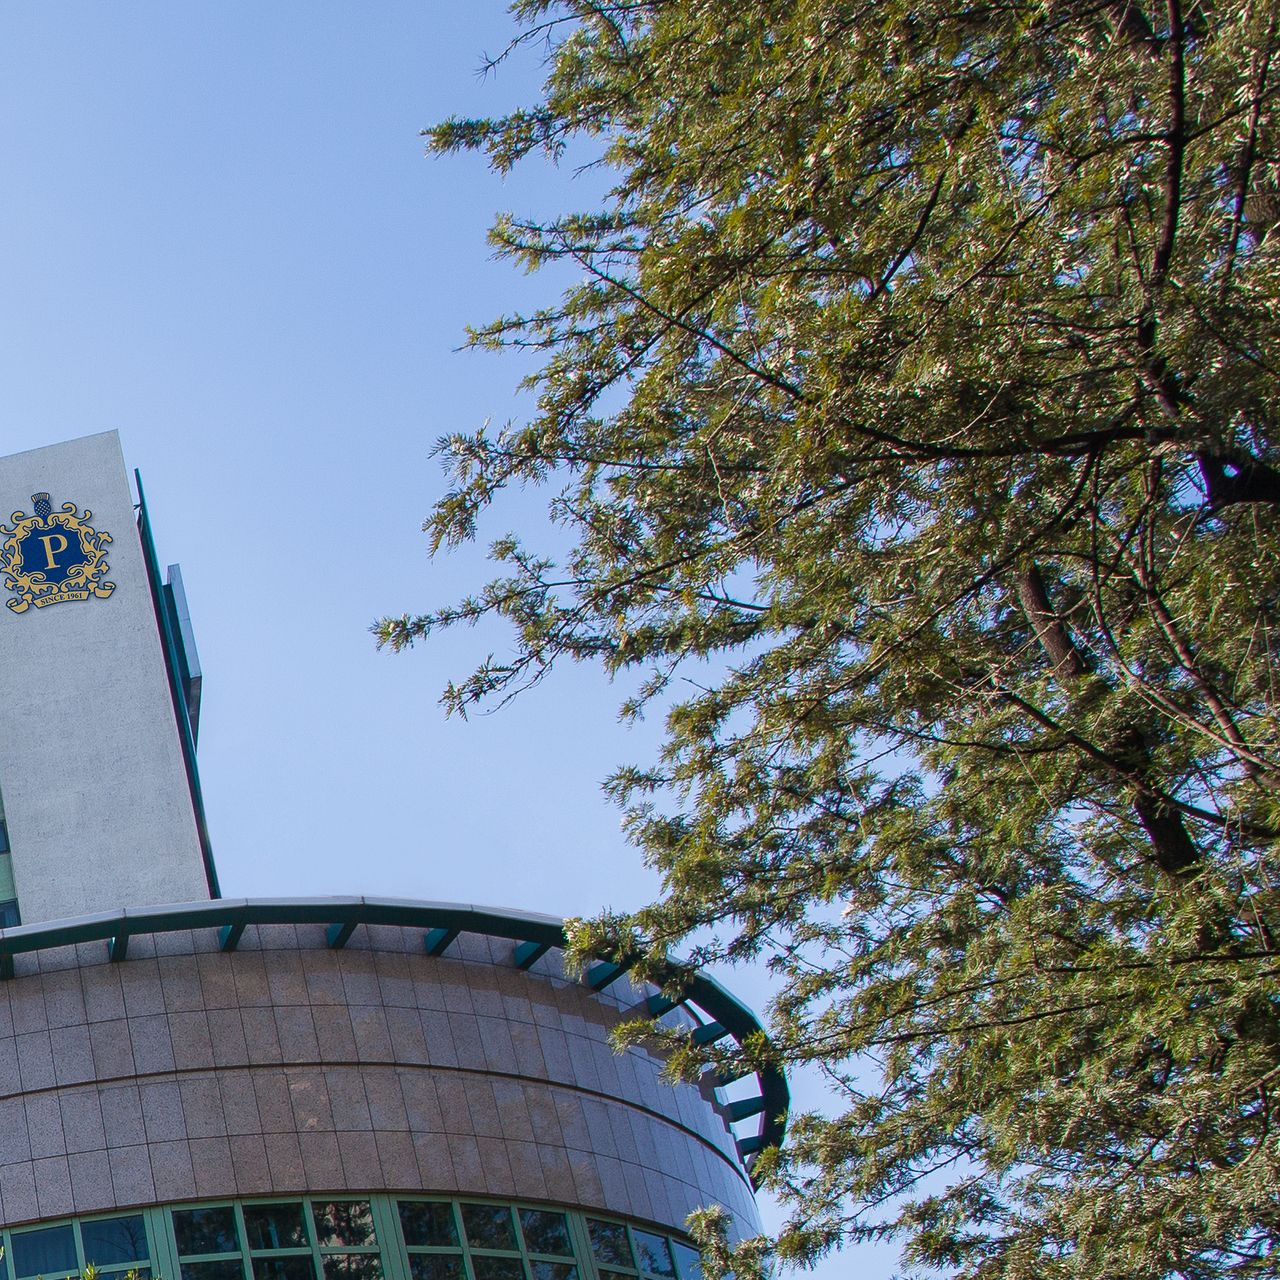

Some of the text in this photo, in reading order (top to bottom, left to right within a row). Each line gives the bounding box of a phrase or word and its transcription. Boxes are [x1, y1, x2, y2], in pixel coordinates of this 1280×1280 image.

[38, 534, 68, 570] P
[40, 591, 83, 606] SINCE 1961
